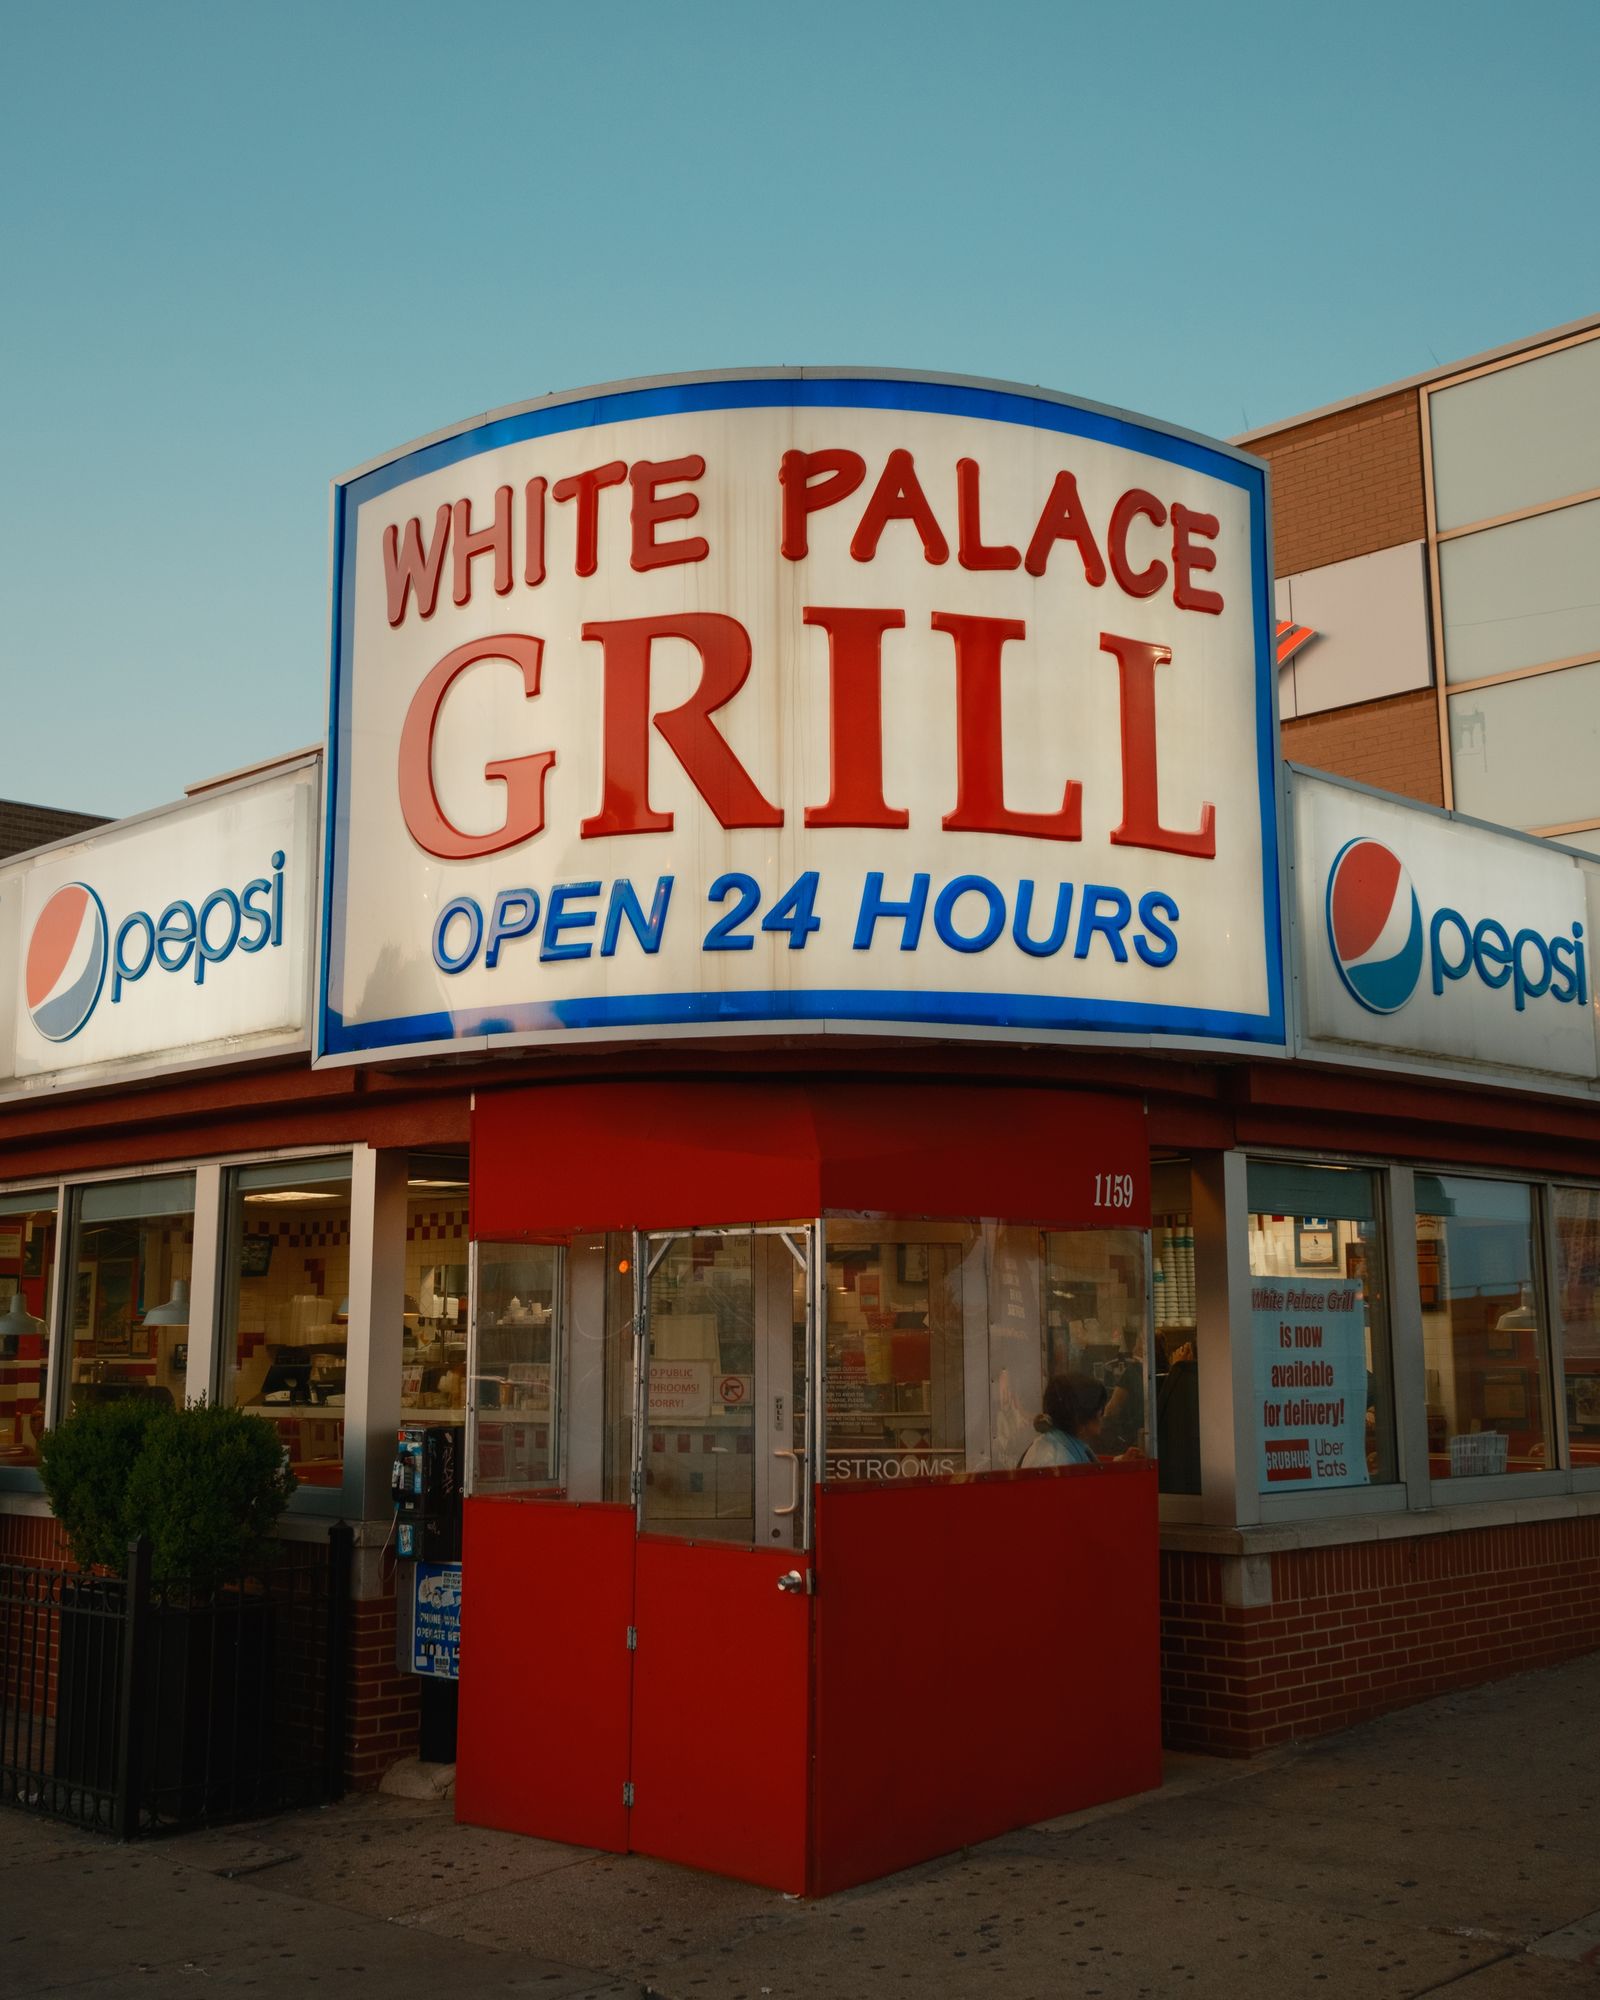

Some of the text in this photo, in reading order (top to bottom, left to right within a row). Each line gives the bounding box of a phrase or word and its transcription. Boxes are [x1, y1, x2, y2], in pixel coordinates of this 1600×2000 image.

[382, 447, 1225, 628] WHITE PALACE
[397, 605, 1216, 860] GRILL
[111, 850, 285, 1003] pepsi
[432, 871, 1180, 975] OPEN 24 HOURS
[1430, 907, 1588, 1012] pepsi
[1093, 1173, 1134, 1208] 1159
[1252, 1288, 1355, 1312] White Palace Grill
[1279, 1321, 1322, 1348] is now
[660, 1369, 693, 1377] PUBLIC
[1271, 1360, 1334, 1388] available
[649, 1383, 700, 1393] THROOMS!
[649, 1399, 685, 1408] SORRY!
[1264, 1398, 1344, 1427] for delivery!
[1315, 1438, 1345, 1457] Uber
[825, 1459, 954, 1480] ESTROOMS
[1266, 1450, 1311, 1470] GRUBHUB
[1317, 1459, 1348, 1477] Eats
[420, 1612, 442, 1625] PHONE
[416, 1626, 445, 1640] OPERATE
